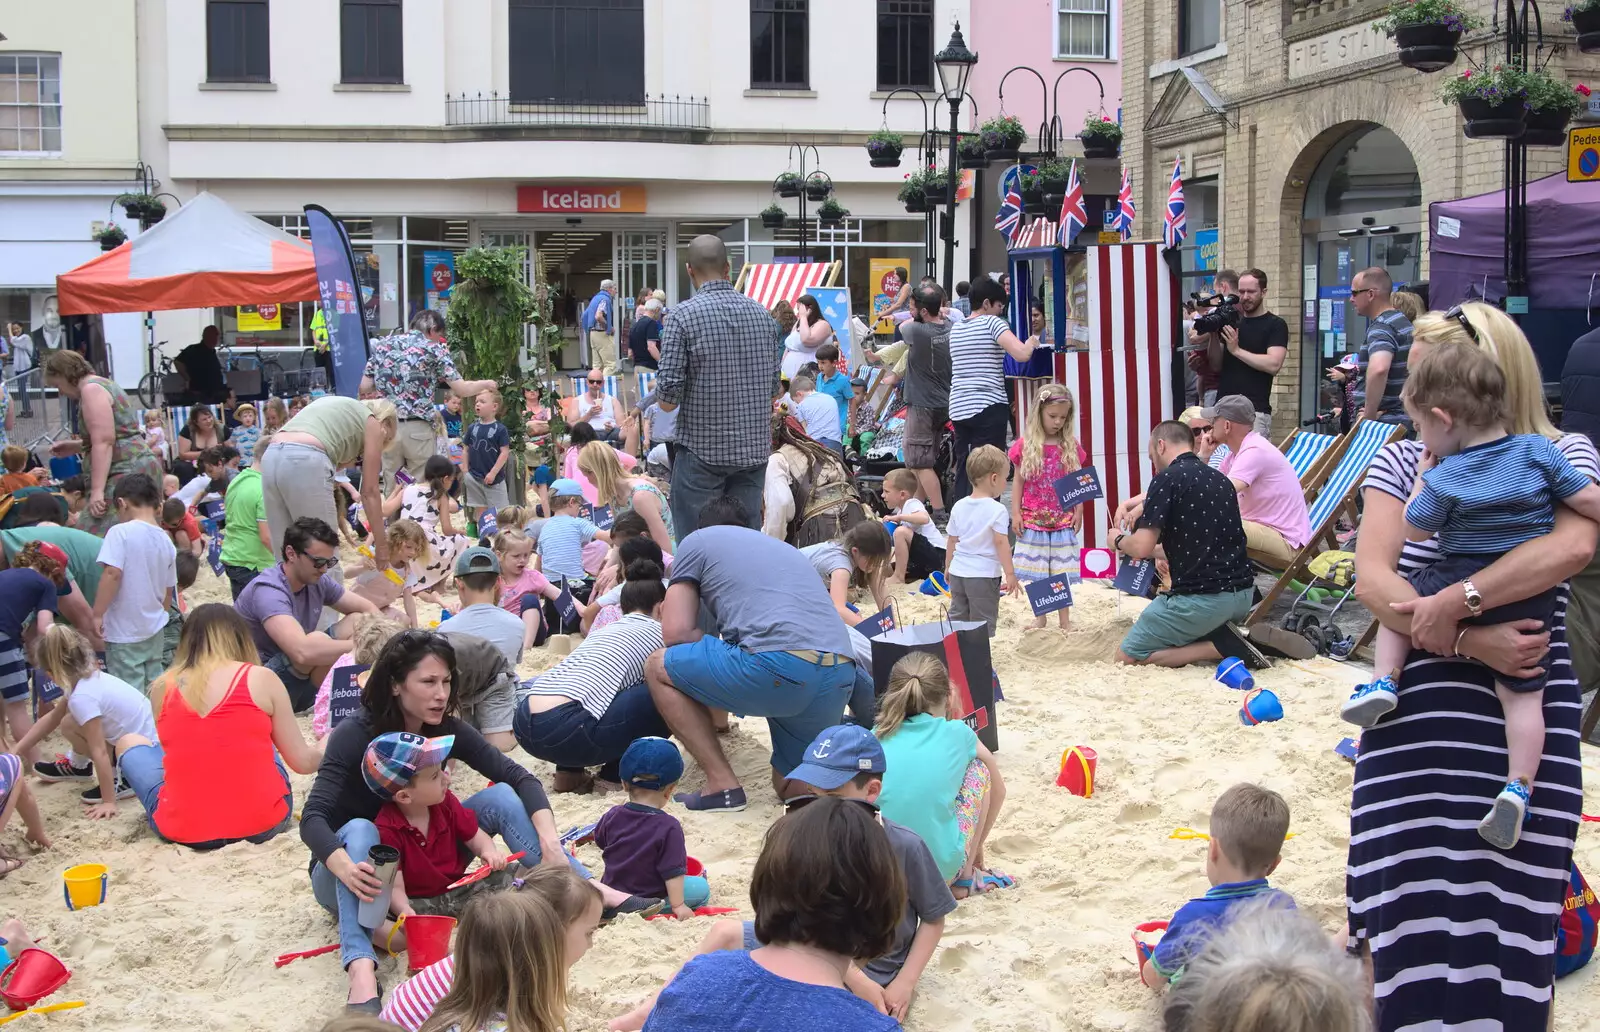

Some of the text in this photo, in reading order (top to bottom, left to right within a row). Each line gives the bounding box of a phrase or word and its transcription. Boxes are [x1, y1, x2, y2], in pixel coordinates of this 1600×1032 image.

[543, 190, 621, 208] Iceland
[884, 284, 900, 292] Pric
[1062, 484, 1098, 503] Lifeboats
[1035, 592, 1068, 608] Lifeboats
